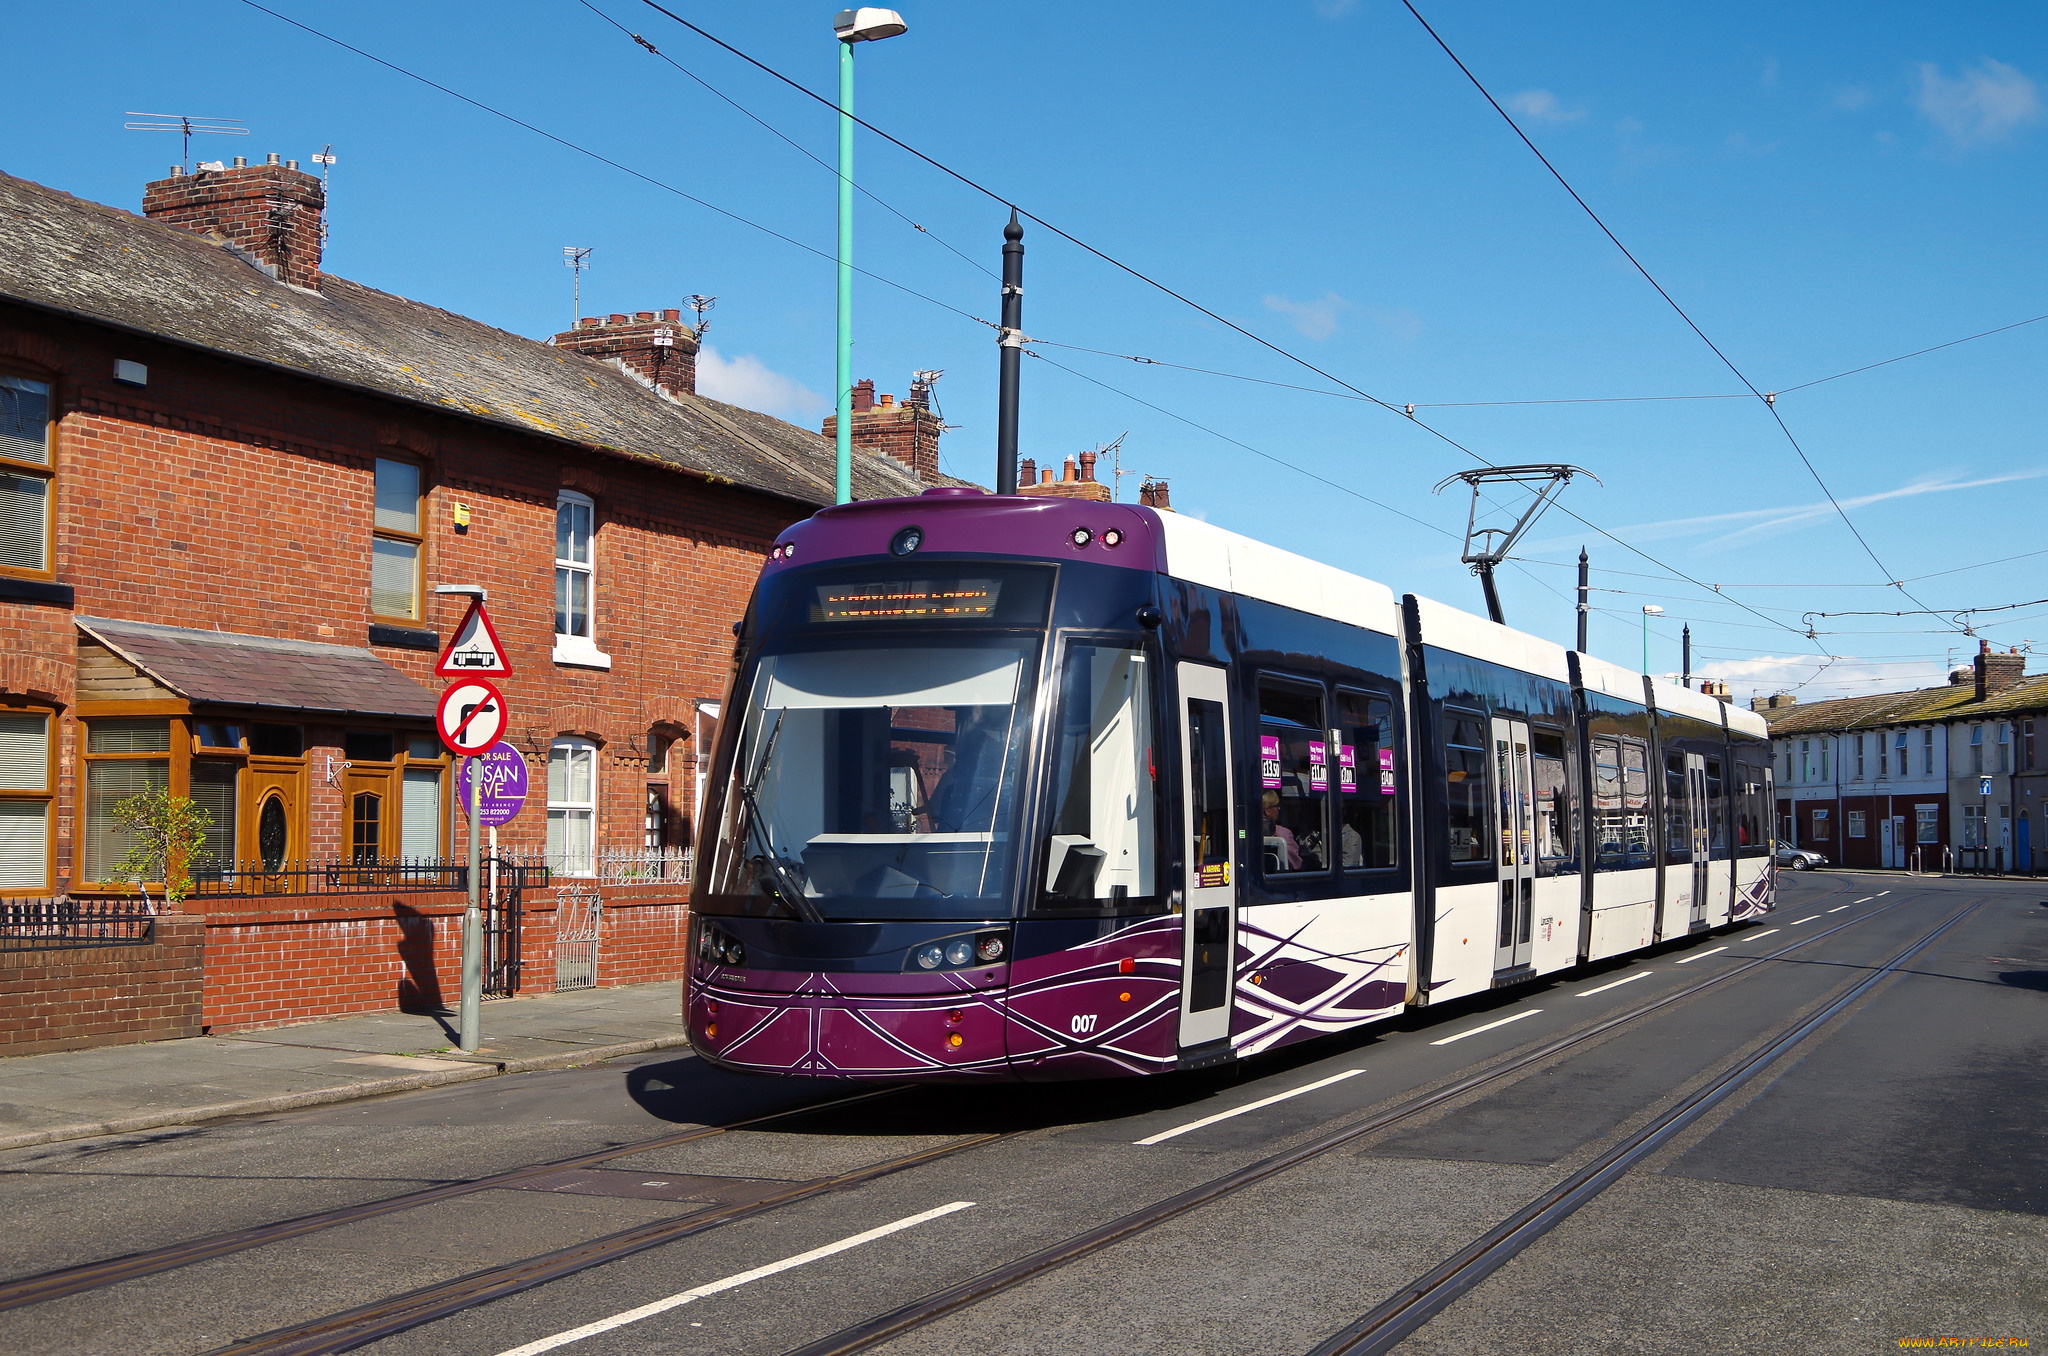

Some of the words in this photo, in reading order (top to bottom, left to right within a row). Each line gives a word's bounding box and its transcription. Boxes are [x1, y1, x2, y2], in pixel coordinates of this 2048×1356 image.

[481, 752, 491, 760] OR
[492, 752, 511, 761] SALE
[1071, 1014, 1098, 1033] 007
